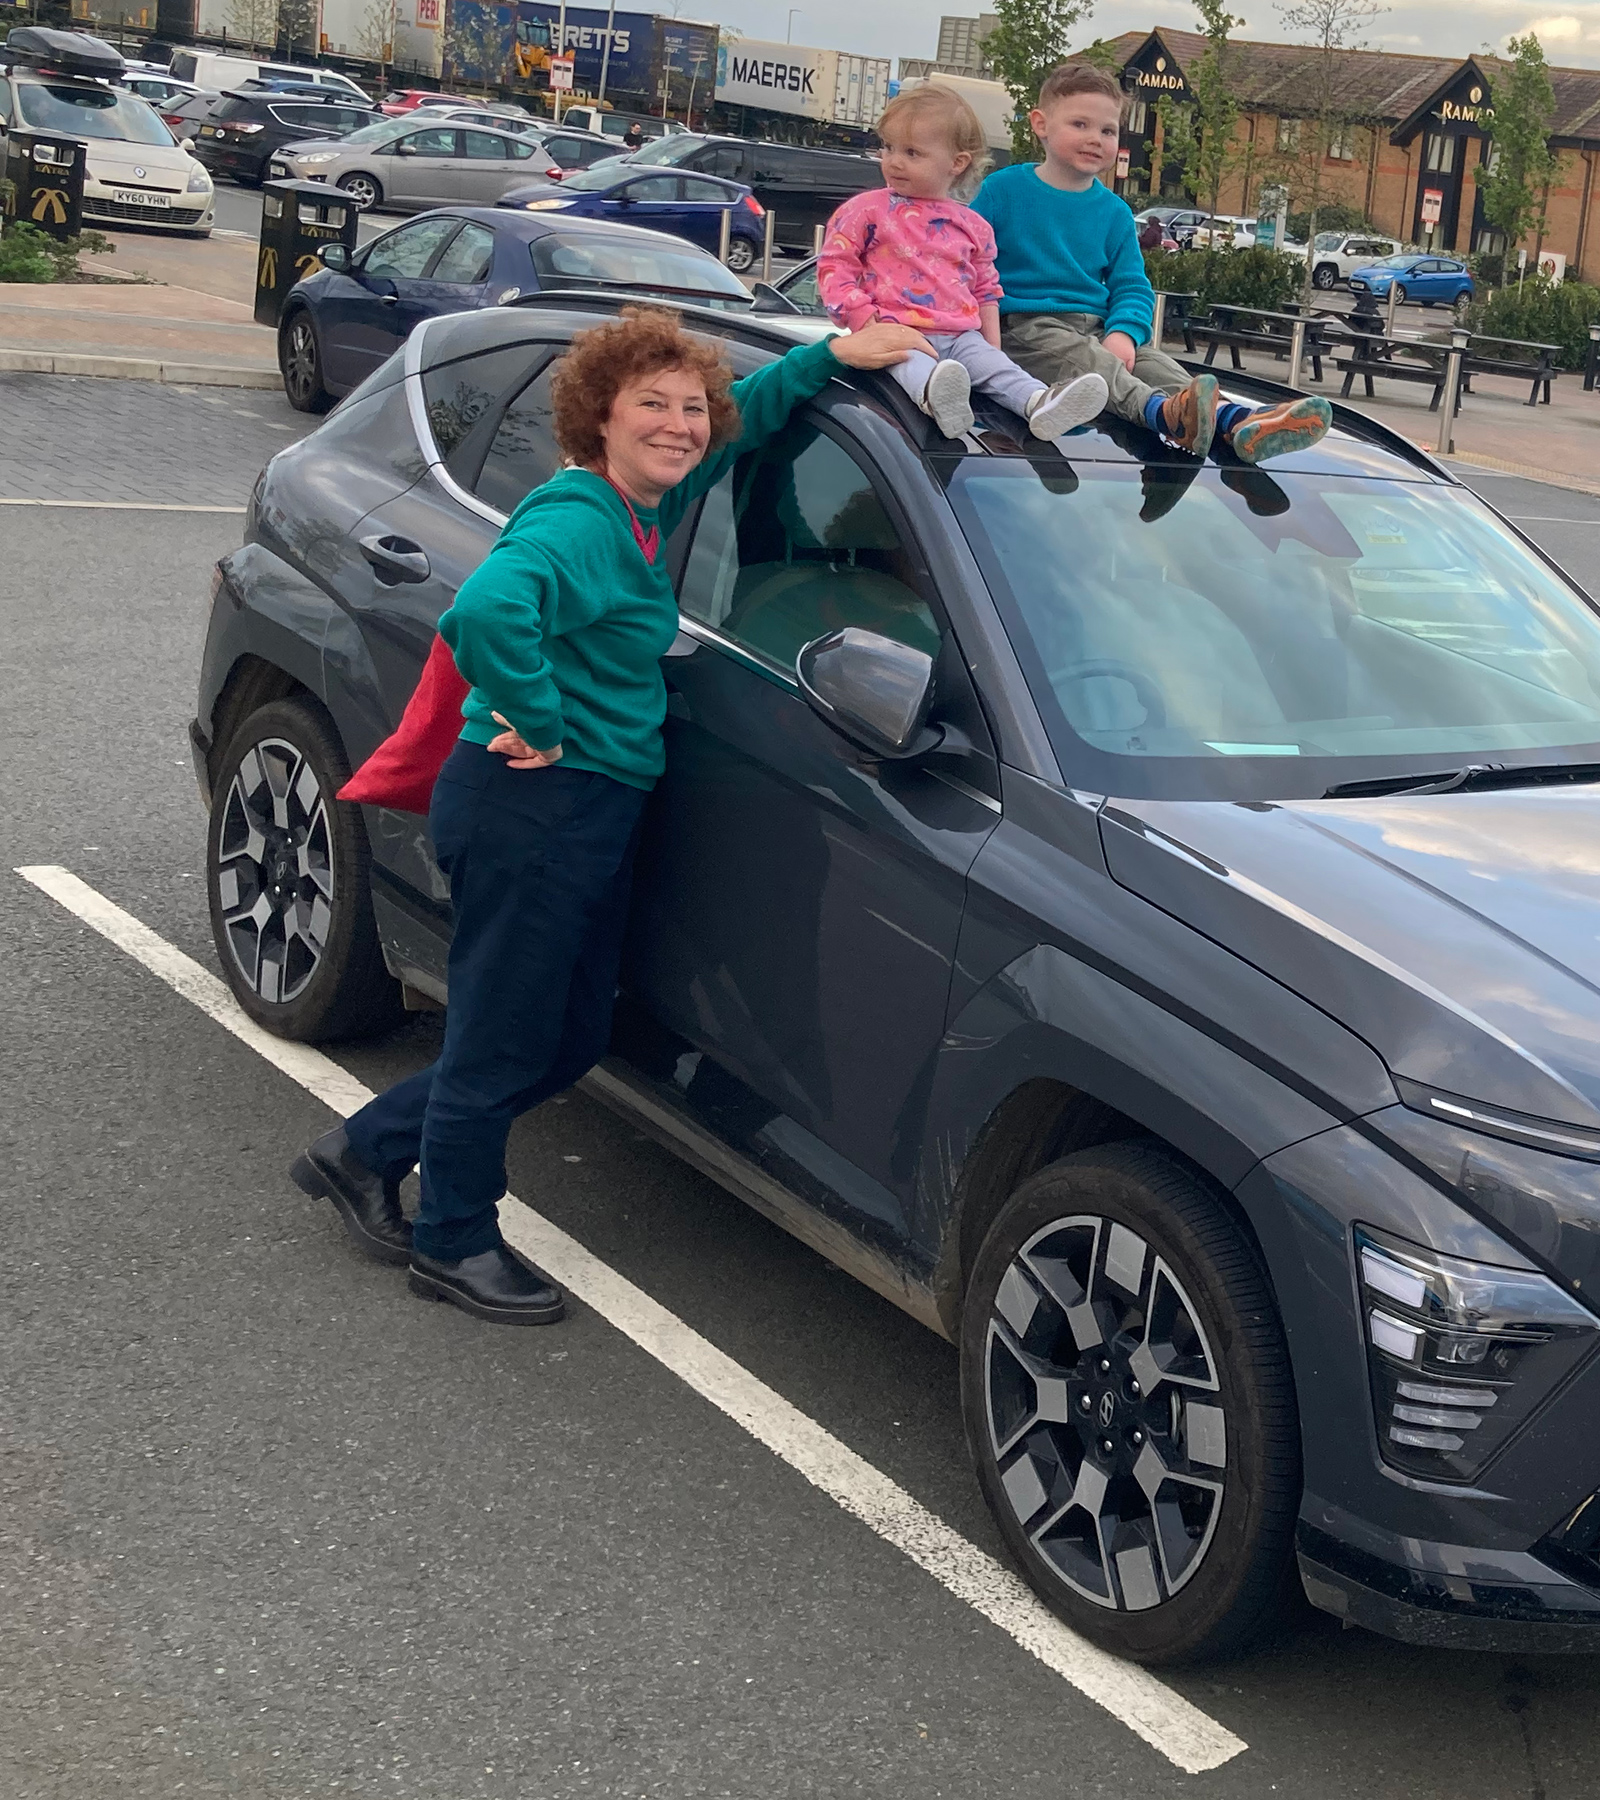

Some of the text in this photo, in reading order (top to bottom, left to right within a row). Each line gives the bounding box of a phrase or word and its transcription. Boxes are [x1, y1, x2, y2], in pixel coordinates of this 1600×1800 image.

[731, 56, 816, 95] MAERSK
[117, 191, 167, 206] KY60 YHN
